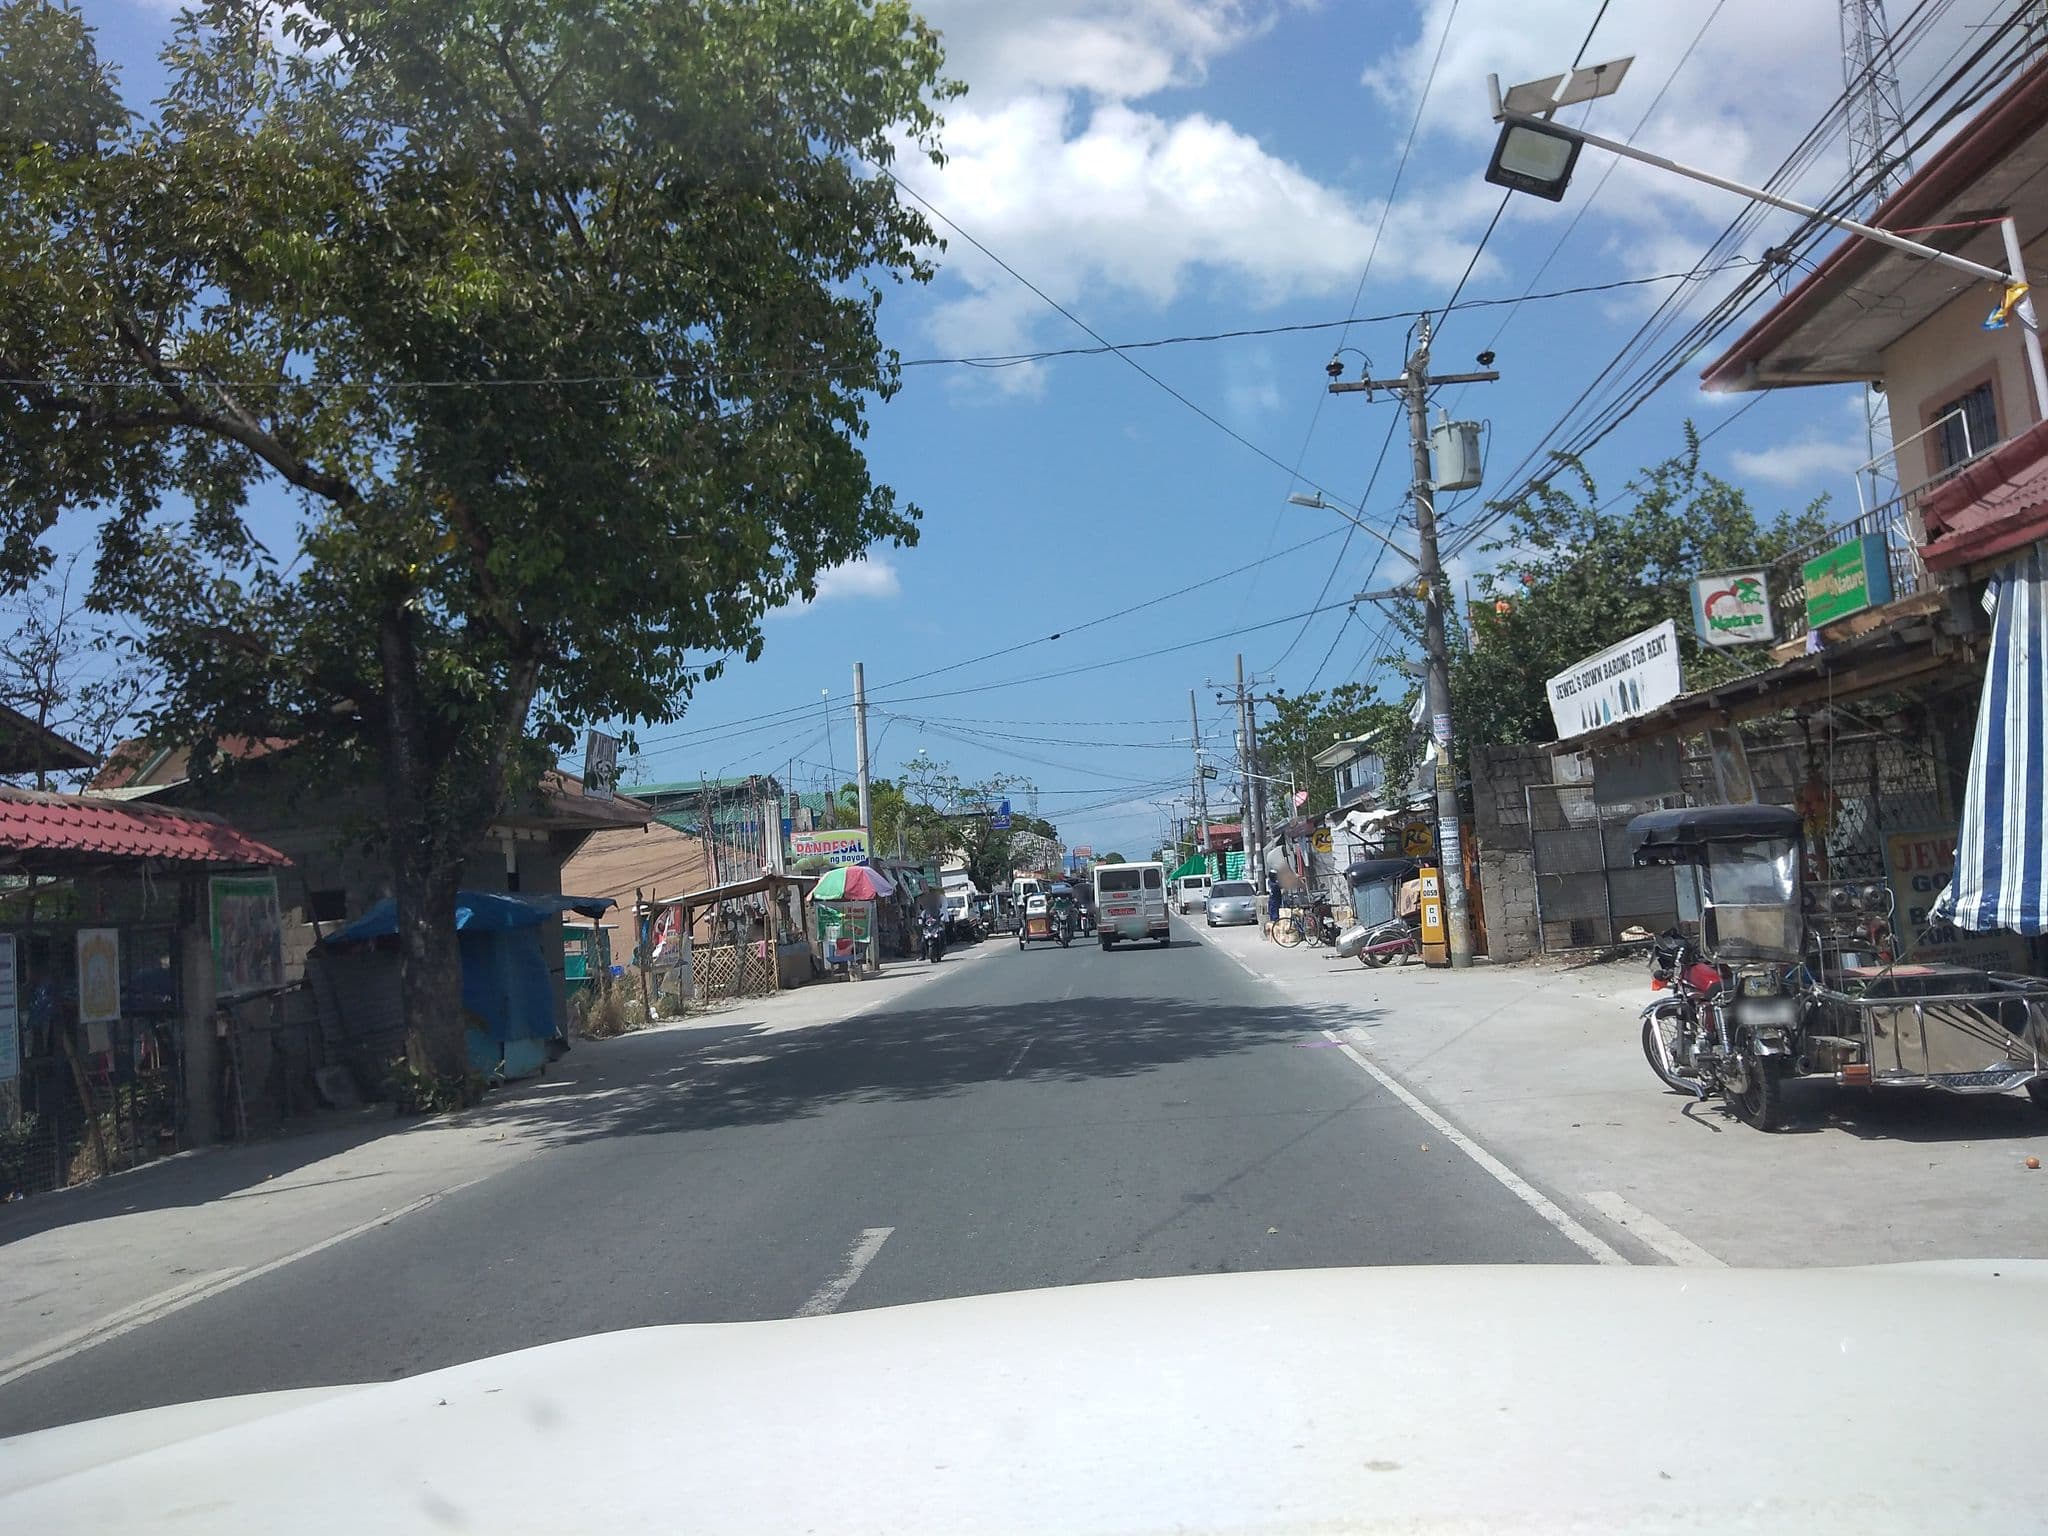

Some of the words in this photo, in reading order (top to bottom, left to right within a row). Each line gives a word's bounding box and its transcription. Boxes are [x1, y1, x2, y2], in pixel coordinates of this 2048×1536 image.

[1710, 614, 1764, 632] Nature
[1555, 674, 1582, 700] JEWEL'S
[1581, 664, 1604, 689] GOWN
[1602, 652, 1632, 679] BARONG
[1631, 645, 1647, 667] FOR
[1646, 634, 1668, 659] RENT
[796, 840, 865, 856] PANDESAL
[1895, 839, 1957, 872] JEW
[830, 856, 840, 864] ng
[1426, 879, 1433, 887] K
